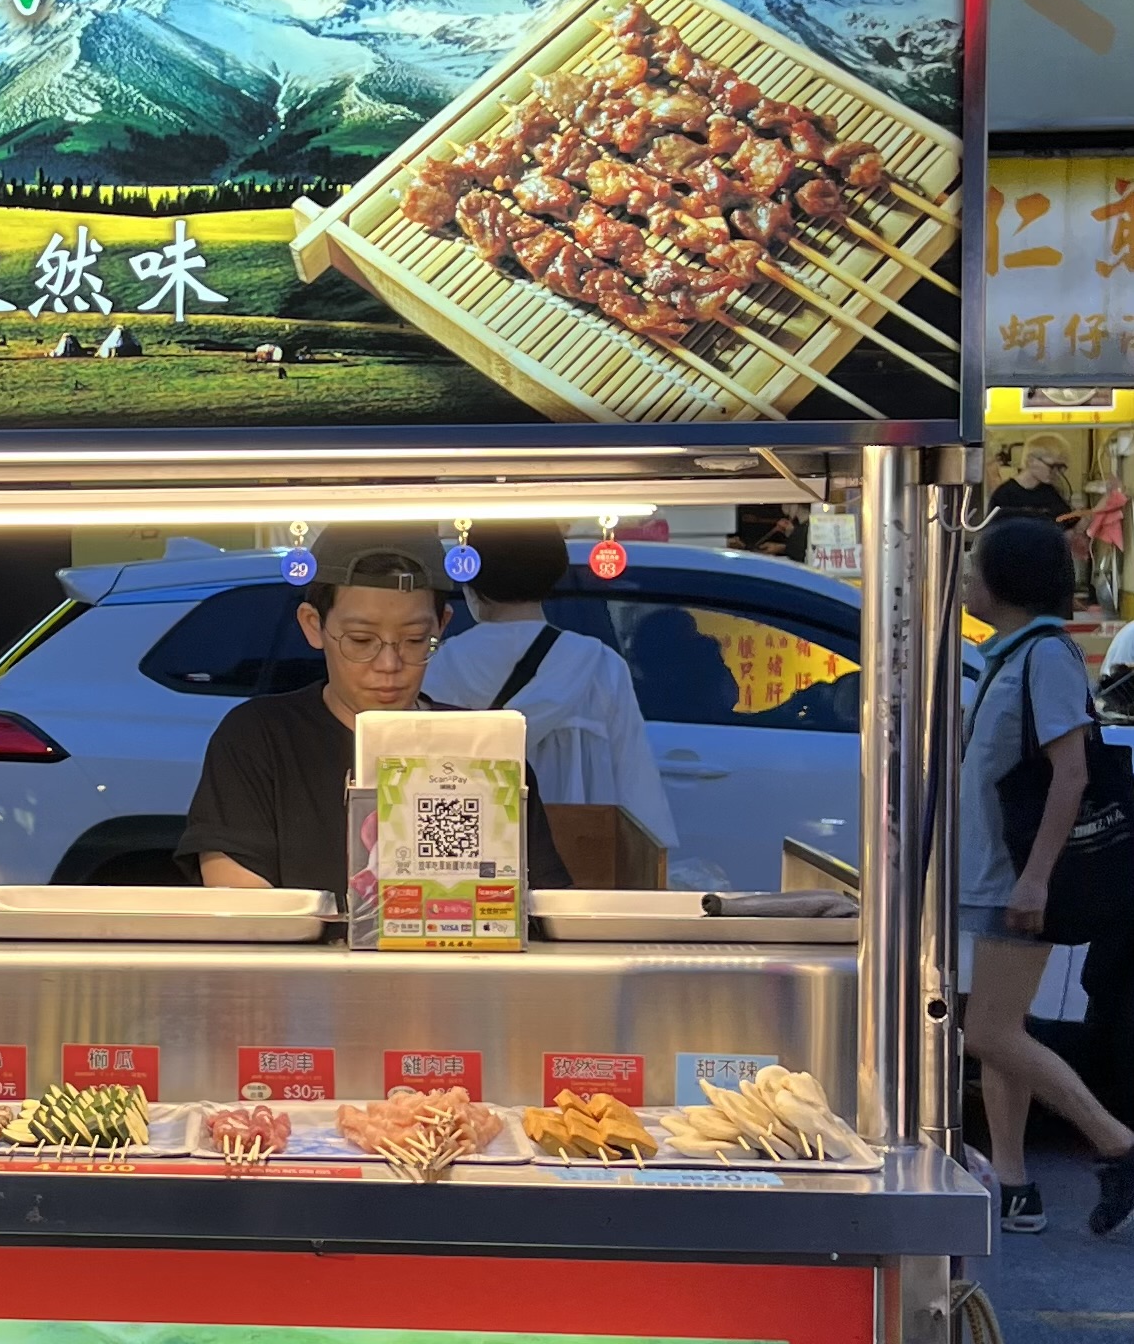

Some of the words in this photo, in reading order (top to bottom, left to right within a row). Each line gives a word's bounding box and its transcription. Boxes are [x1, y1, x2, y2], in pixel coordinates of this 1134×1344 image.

[999, 313, 1134, 361] 蚵仔
[289, 560, 309, 578] 29
[451, 555, 476, 574] 30
[258, 1051, 314, 1074] 豬肉串
[401, 1054, 464, 1076] 雞肉串
[552, 1057, 637, 1081] 孜然豆干
[695, 1058, 759, 1080] 甜不辣
[283, 1084, 326, 1100] $30元
